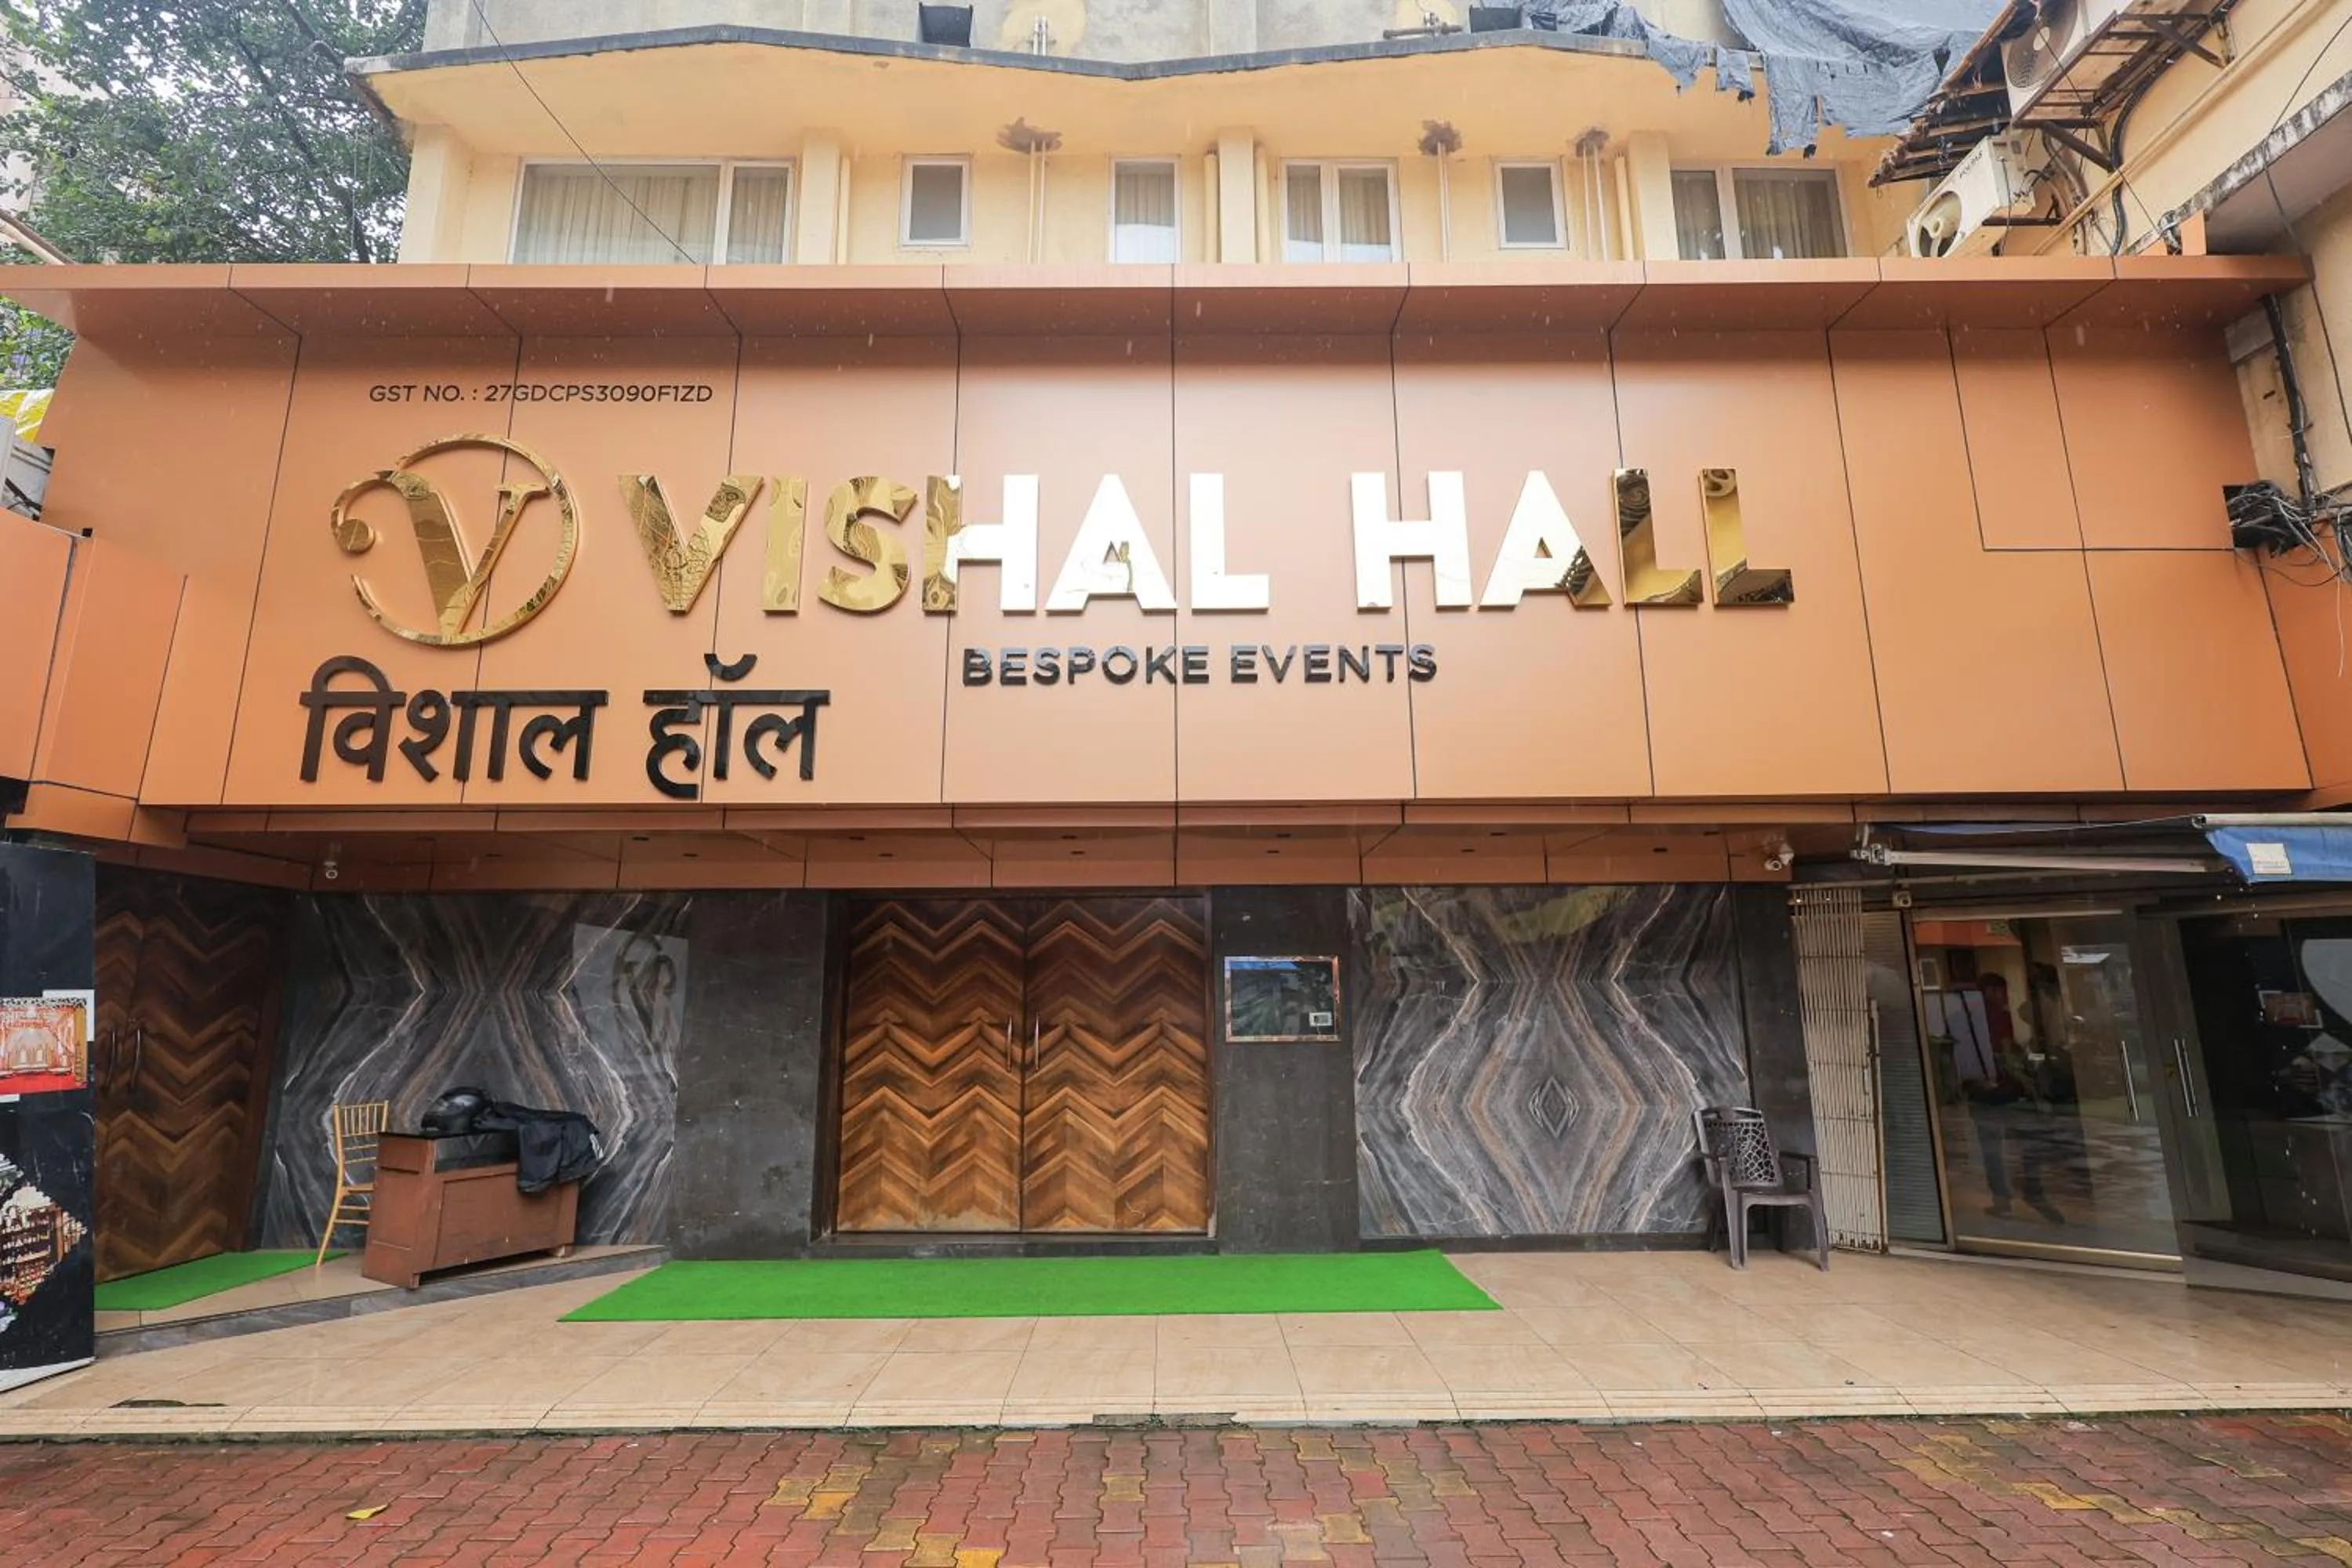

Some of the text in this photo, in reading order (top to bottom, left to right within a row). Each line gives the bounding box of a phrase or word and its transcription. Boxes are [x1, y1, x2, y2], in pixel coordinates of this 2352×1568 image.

[369, 385, 416, 402] GST
[423, 385, 465, 402] NO.
[619, 468, 1795, 615] VISHAL HALL
[963, 644, 1437, 688] BESPOKE EVENTS
[299, 653, 831, 800] विशाल हॉल
